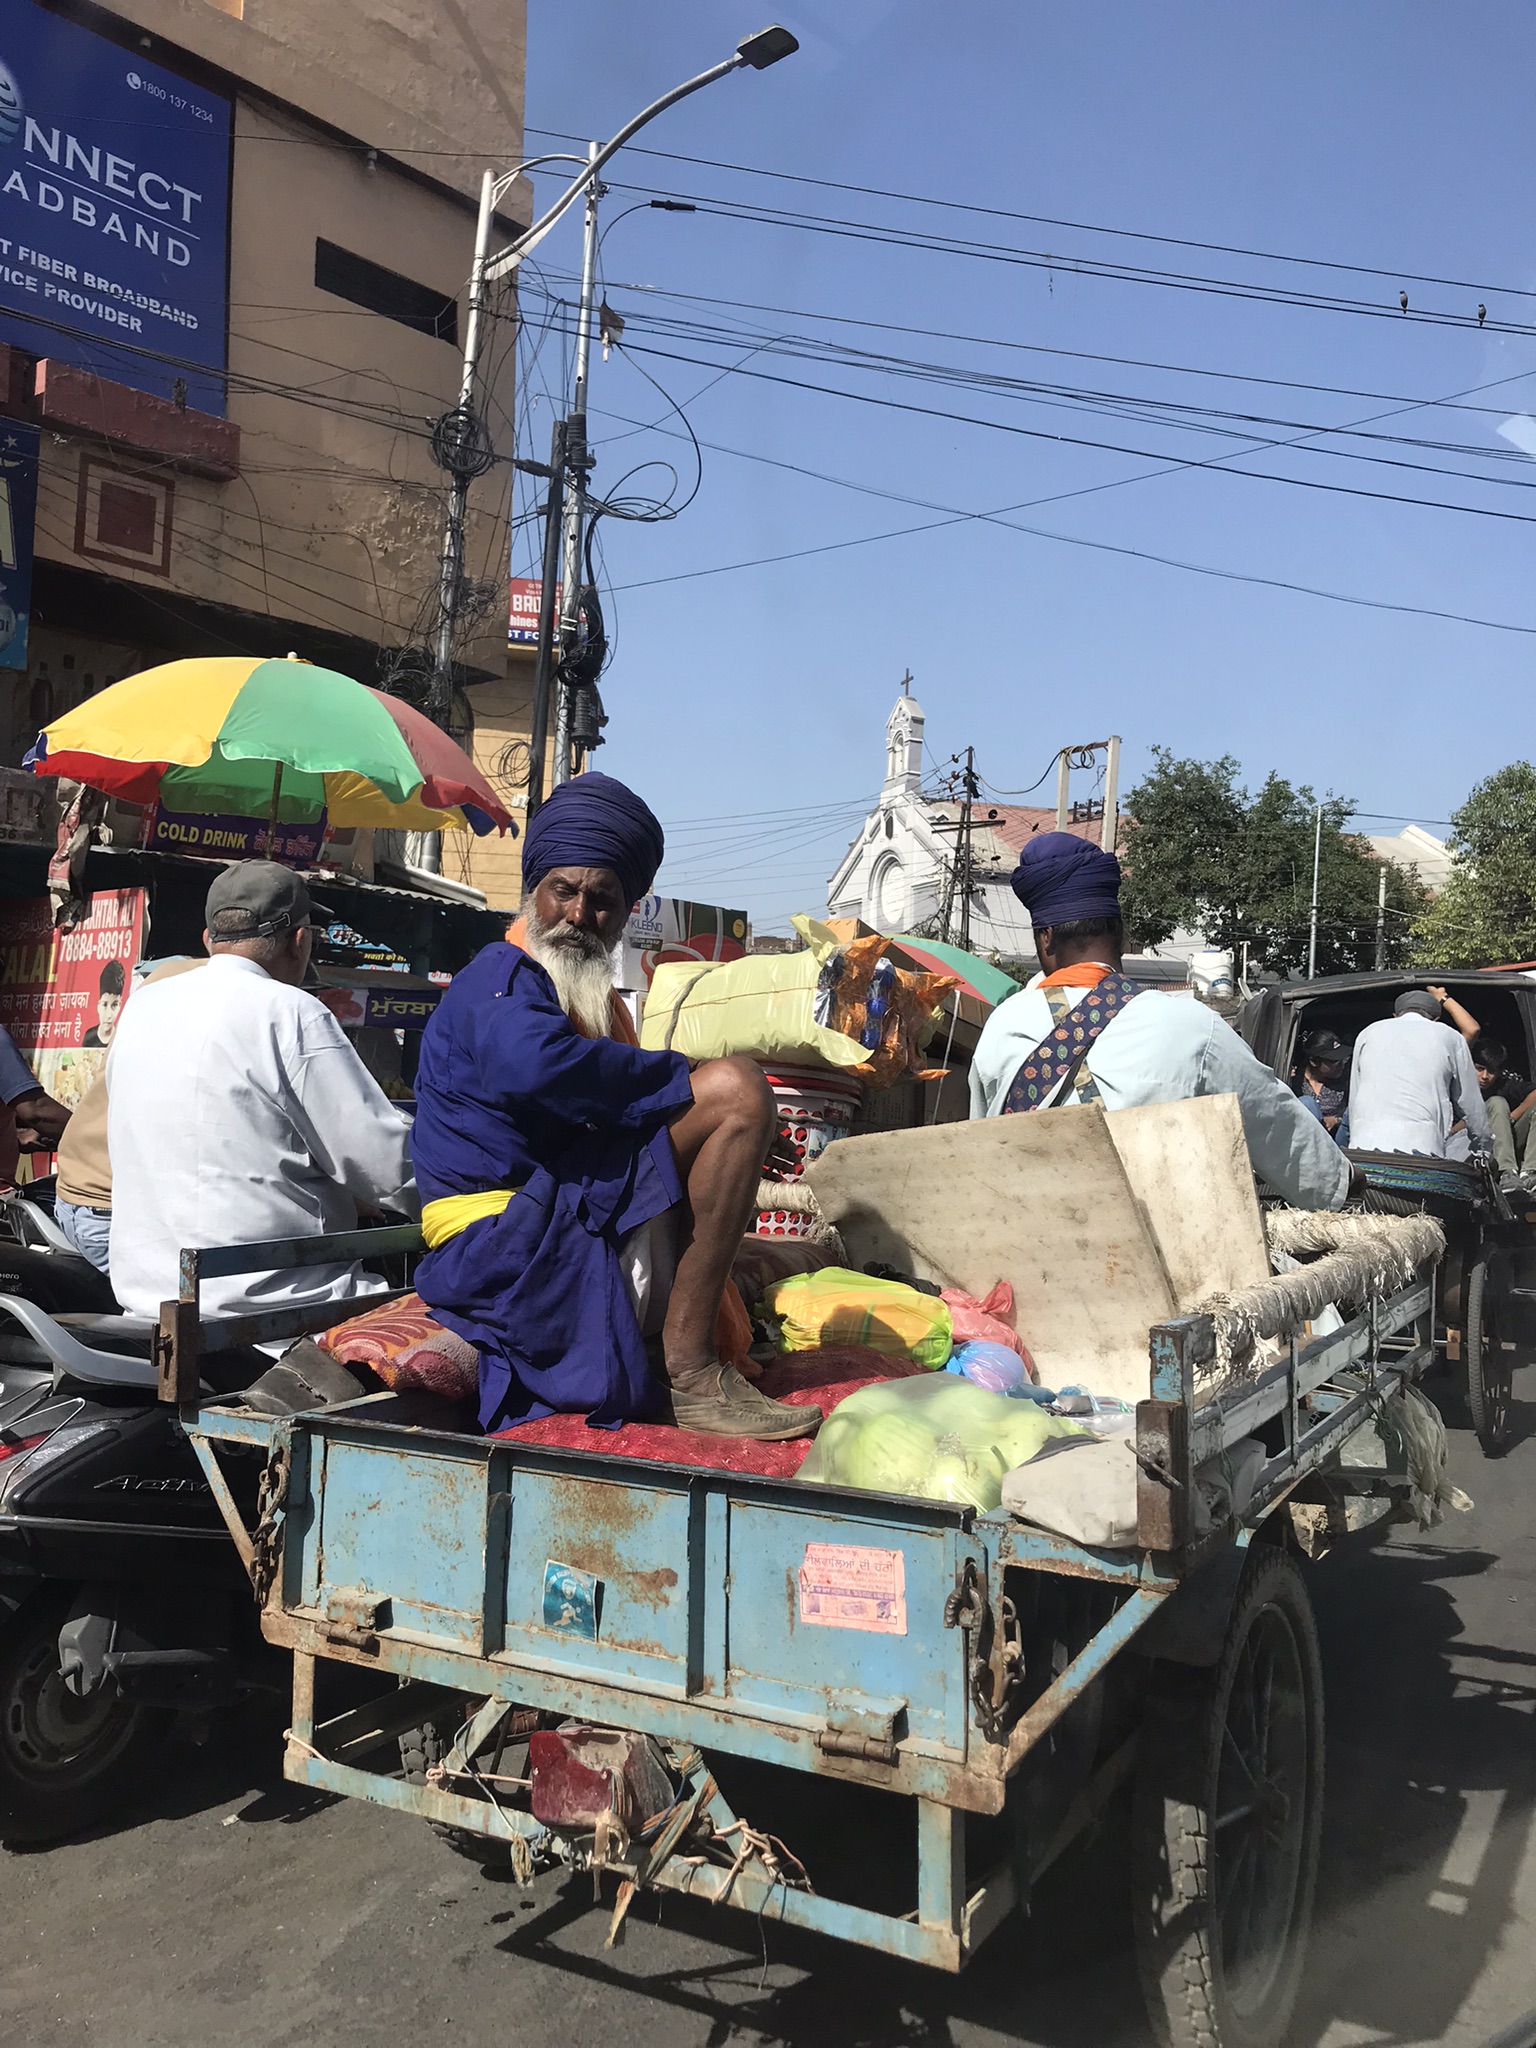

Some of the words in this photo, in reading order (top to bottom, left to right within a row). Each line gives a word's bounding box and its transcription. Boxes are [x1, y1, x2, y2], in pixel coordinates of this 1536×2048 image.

[142, 81, 167, 100] 1800
[169, 94, 188, 110] 137
[190, 104, 214, 124] 1234
[1, 169, 191, 267] ADBAND
[18, 245, 78, 283] FIBER
[83, 271, 200, 331] BROADBAND
[44, 282, 144, 334] PROVIDER
[157, 821, 200, 844] COLD
[202, 828, 249, 850] DRINK
[630, 917, 663, 933] KLEENO
[60, 929, 133, 963] 78884-88913
[54, 1021, 72, 1039] मना
[74, 1012, 83, 1042] है
